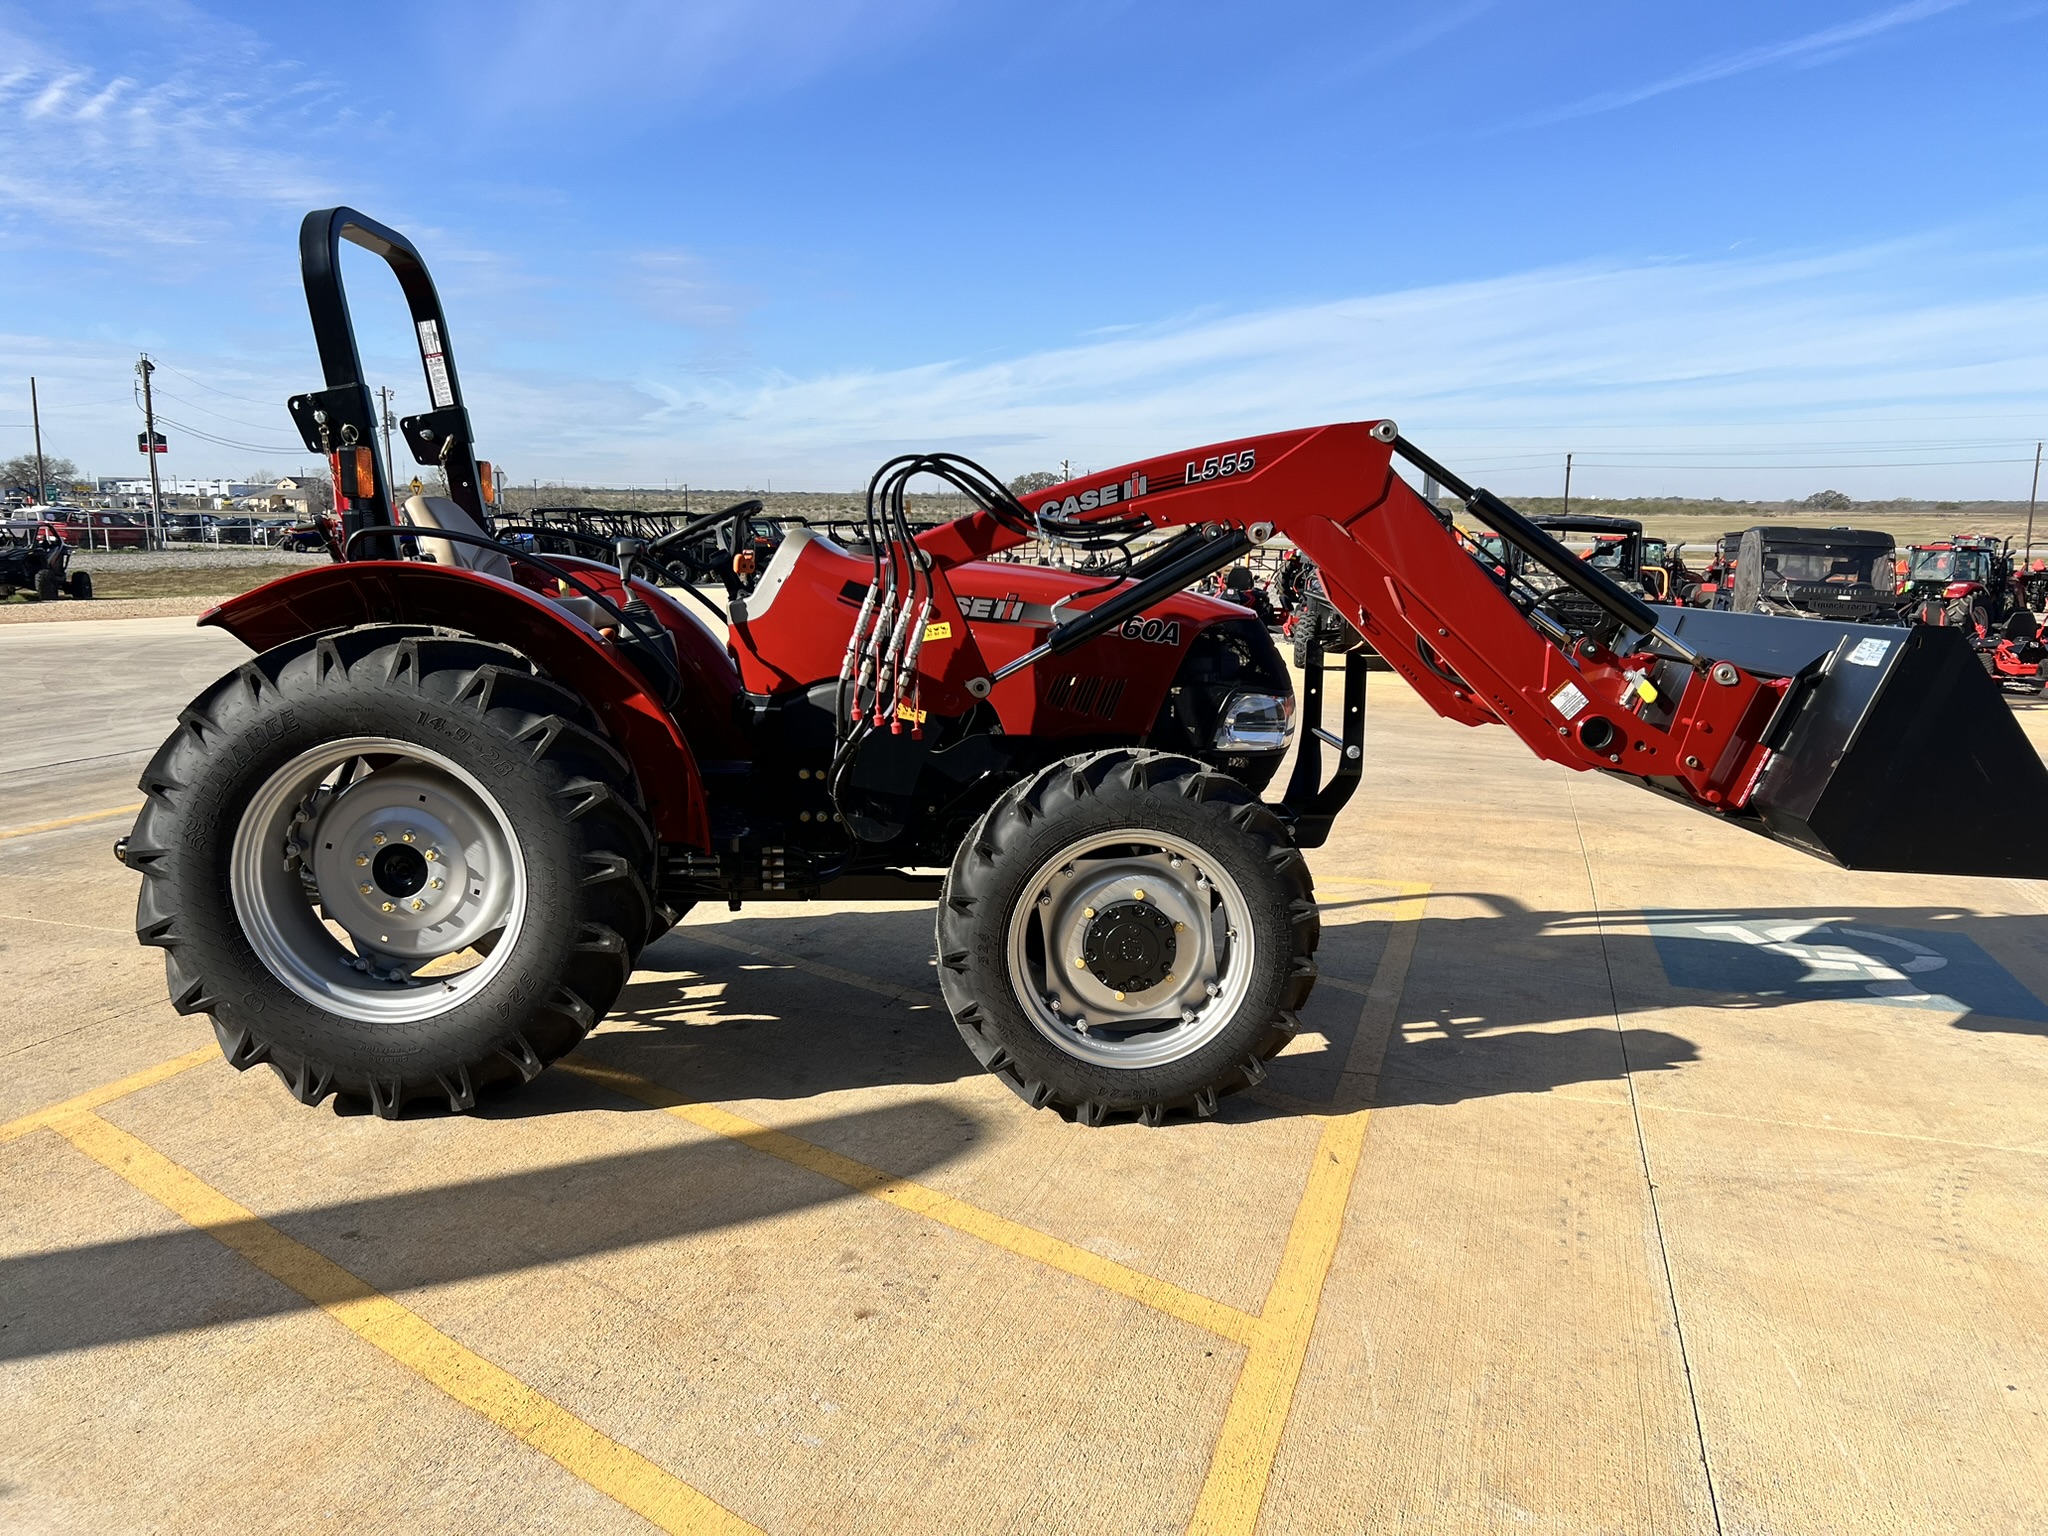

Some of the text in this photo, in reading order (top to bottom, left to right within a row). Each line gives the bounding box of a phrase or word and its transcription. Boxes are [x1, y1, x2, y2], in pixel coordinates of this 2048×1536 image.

[1039, 484, 1118, 521] CASE
[1185, 449, 1255, 484] L555
[956, 596, 993, 618] SE
[1121, 615, 1179, 646] 60A
[192, 708, 300, 829] ALLIANCE
[415, 710, 513, 777] 14.9-28
[494, 969, 537, 1020] 324
